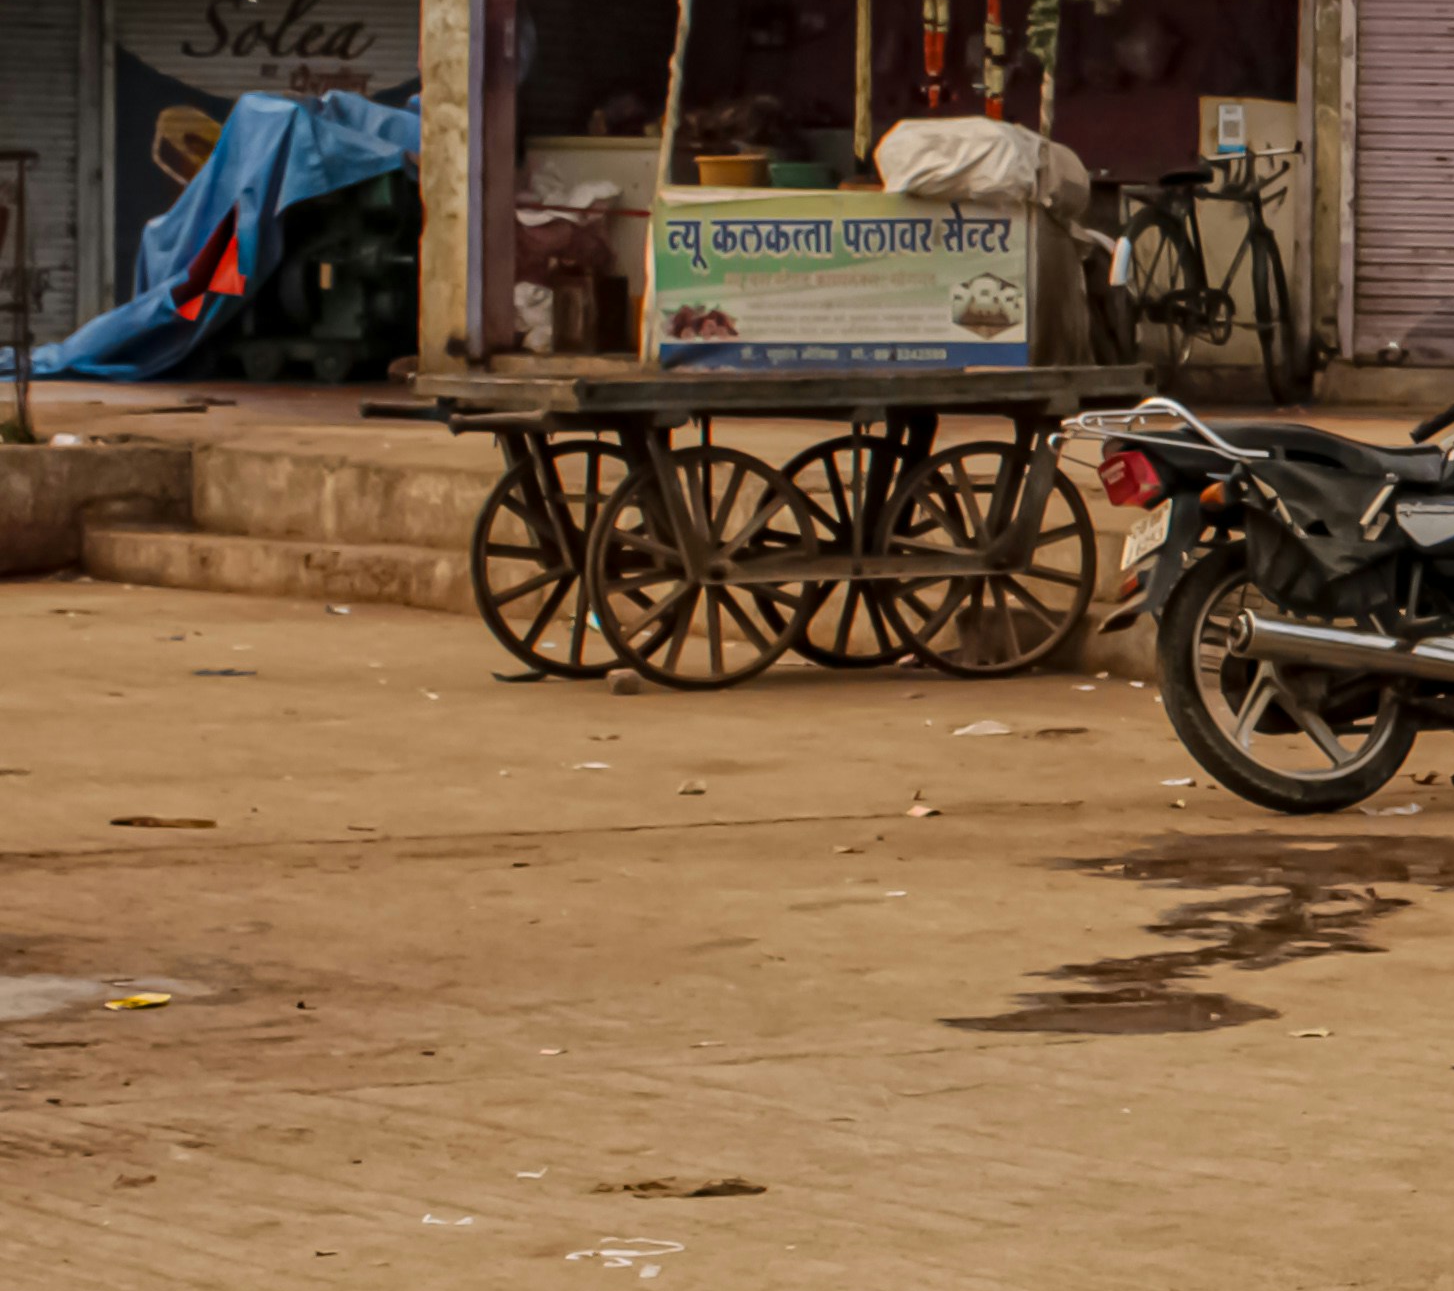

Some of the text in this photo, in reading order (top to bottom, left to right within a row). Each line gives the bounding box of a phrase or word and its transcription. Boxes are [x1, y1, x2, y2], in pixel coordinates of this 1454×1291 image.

[666, 219, 708, 269] न्यू
[711, 219, 833, 254] कलकत्ता
[942, 202, 1012, 253] सेन्टर
